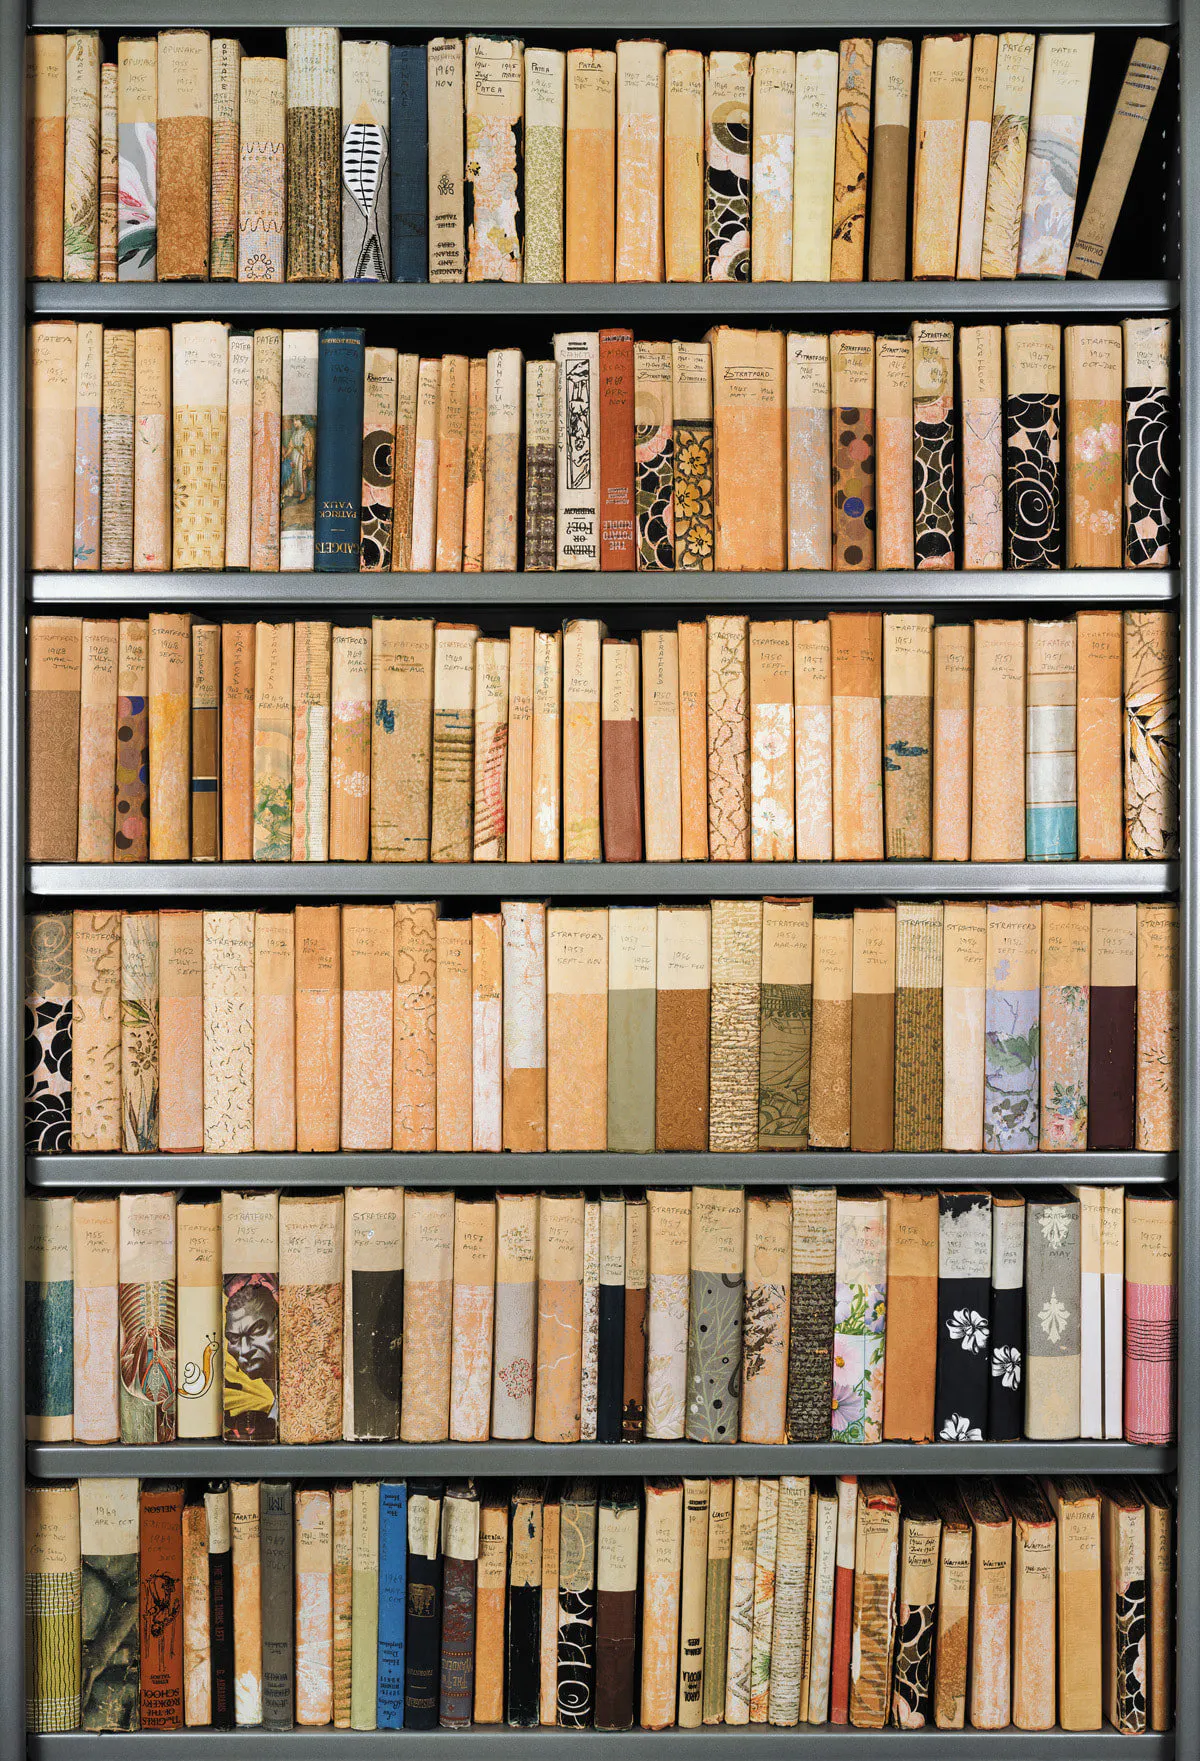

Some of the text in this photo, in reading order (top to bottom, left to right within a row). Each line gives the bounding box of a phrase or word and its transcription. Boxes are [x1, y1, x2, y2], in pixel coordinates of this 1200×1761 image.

[435, 65, 455, 76] 1969
[476, 81, 502, 94] PATEA
[724, 368, 770, 379] STRATFORD
[323, 501, 353, 509] VAUX
[320, 511, 357, 519] PATRICK
[566, 522, 594, 535] FOE?
[603, 520, 633, 530] RIDDLE
[602, 531, 633, 540] POTATO
[563, 544, 596, 558] FRIEND
[609, 541, 627, 551] THE
[766, 920, 809, 928] STRATFORD
[990, 922, 1037, 931] STRATFORD
[550, 932, 603, 940] STRATFORD
[144, 1504, 176, 1513] NELSON
[1066, 1512, 1095, 1520] WAITARA
[141, 1688, 180, 1699] SCHOOL
[141, 1697, 181, 1707] ROOKERY
[142, 1716, 167, 1726] GIRLS
